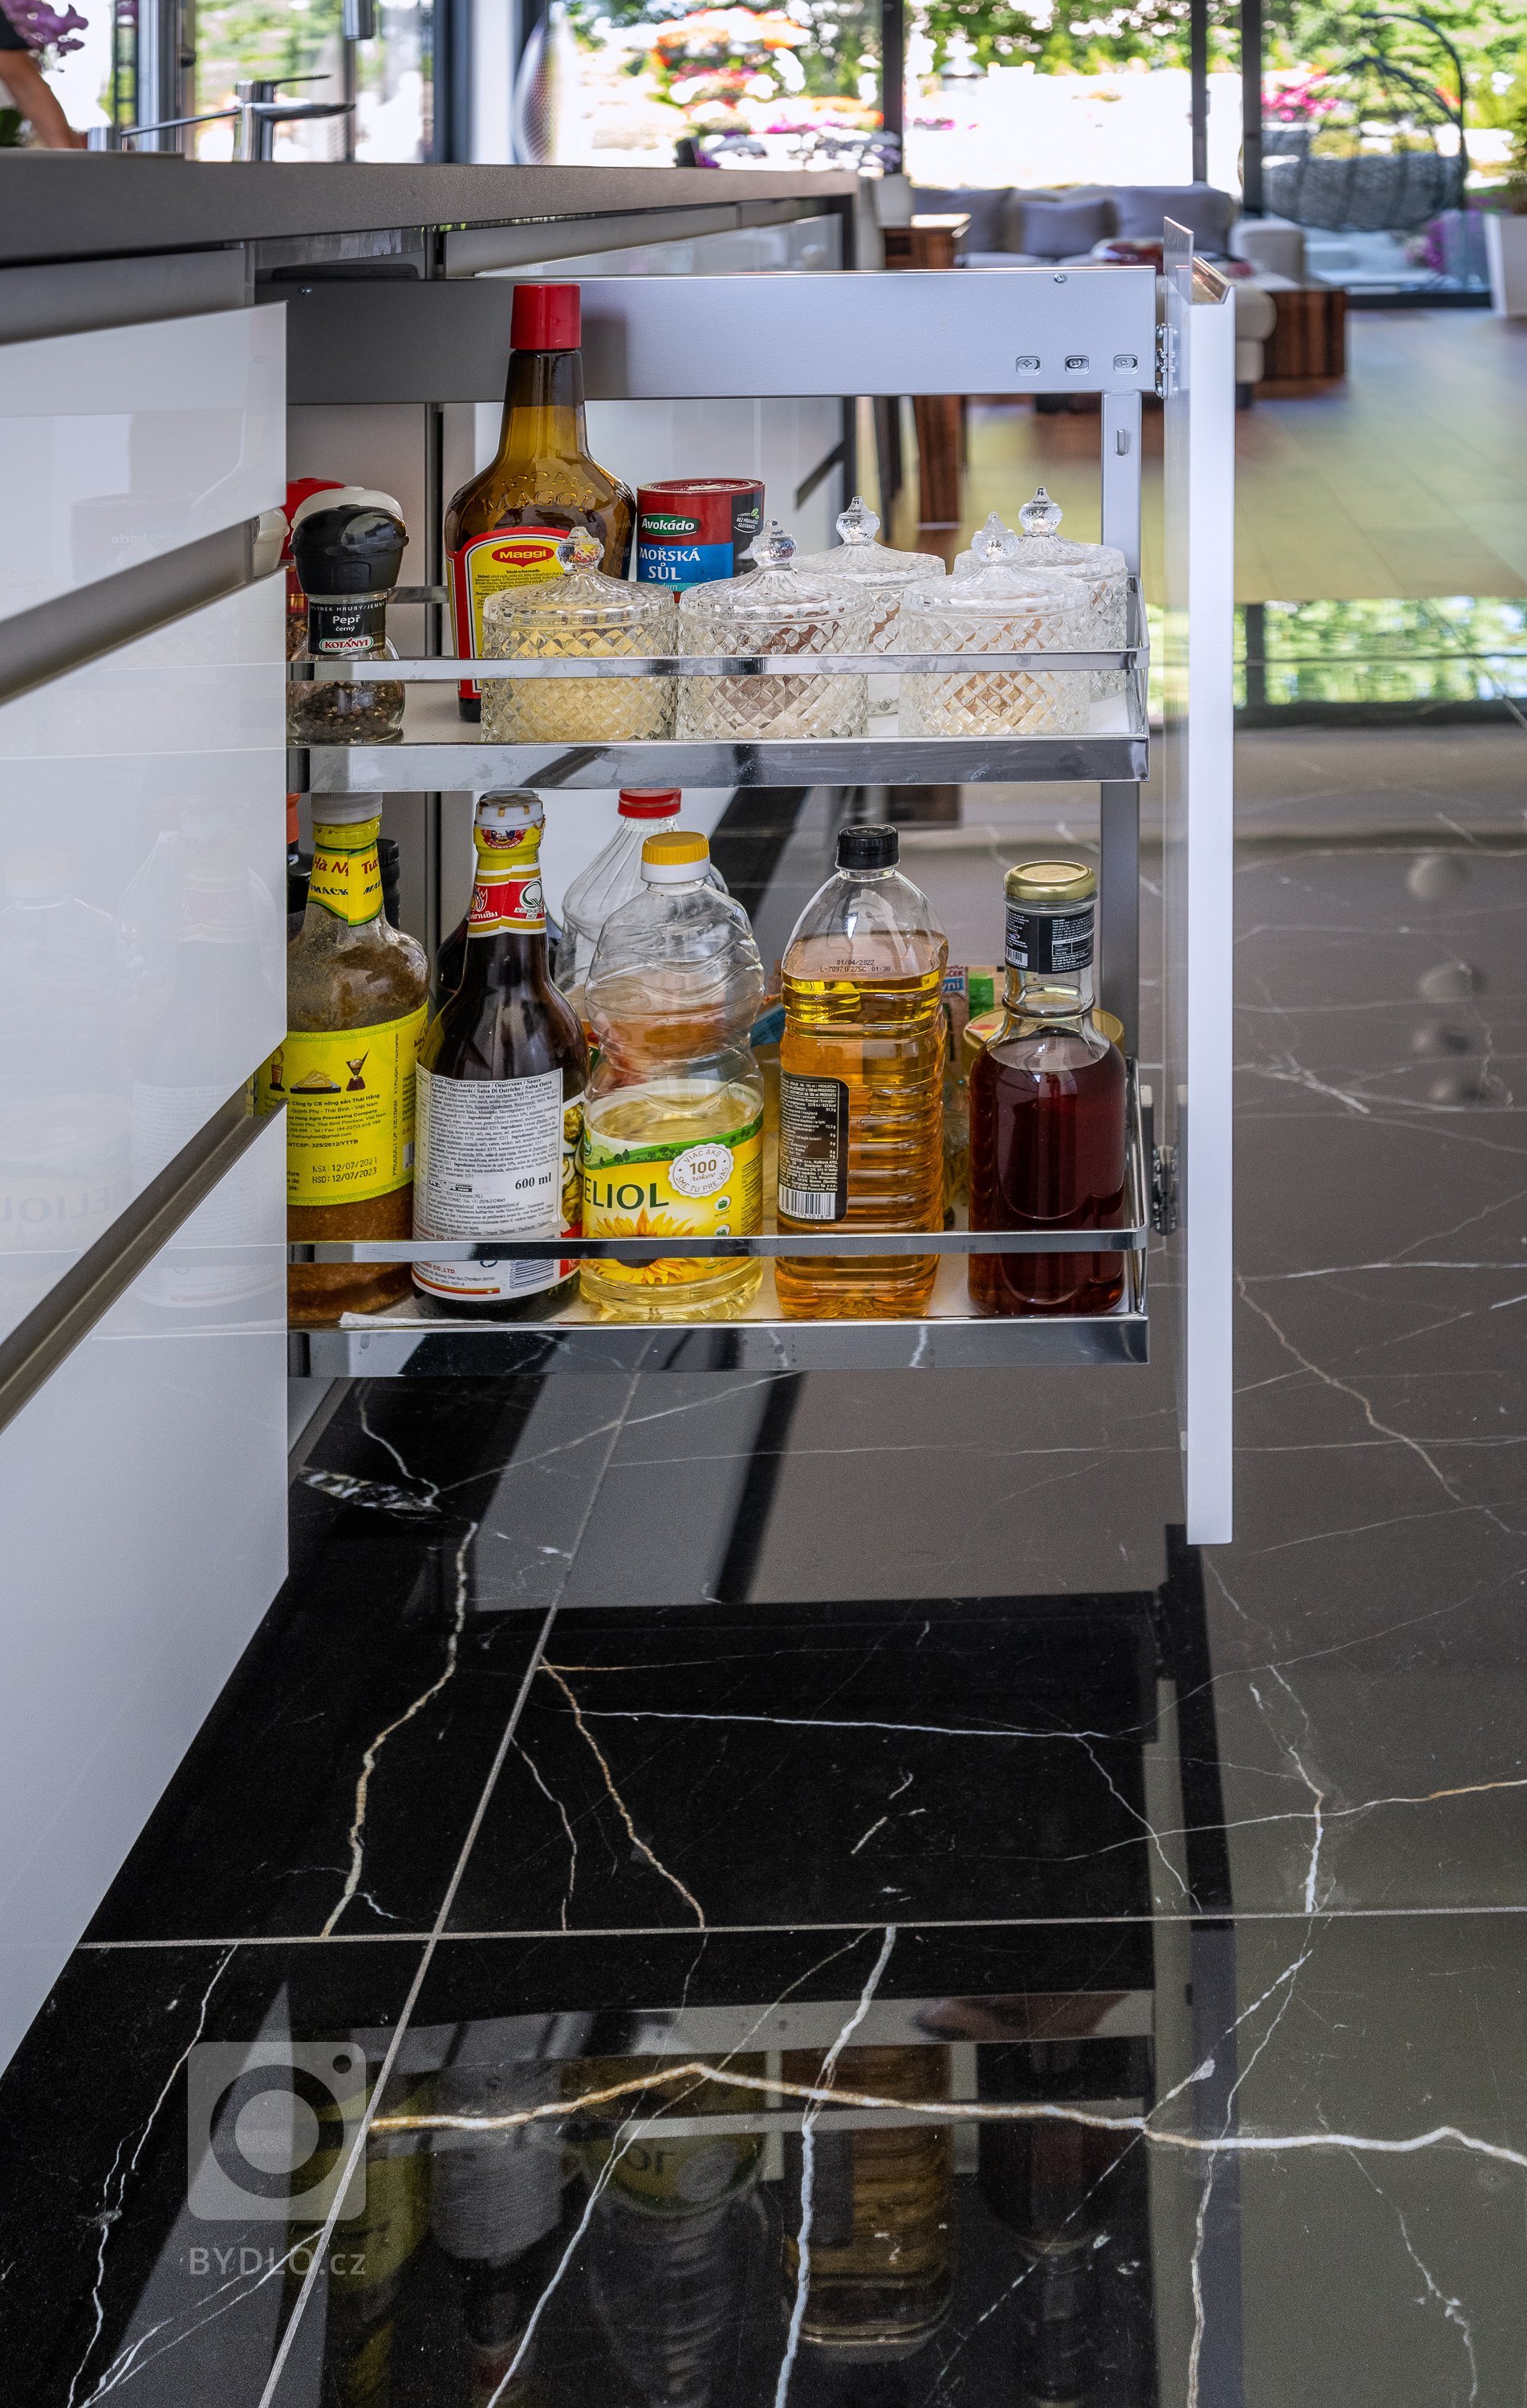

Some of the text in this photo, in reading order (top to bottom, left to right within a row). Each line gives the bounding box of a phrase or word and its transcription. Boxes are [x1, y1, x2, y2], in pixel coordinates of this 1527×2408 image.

[642, 518, 695, 531] Avokádo
[500, 549, 546, 559] Maggi
[639, 547, 701, 562] MOŘSKÁ
[648, 563, 682, 580] SŮL
[333, 614, 361, 624] Pepř
[324, 637, 369, 649] KOTÁNYI
[313, 856, 328, 872] Hà
[366, 1100, 380, 1108] Nam
[323, 1113, 353, 1121] Processing
[353, 1108, 379, 1117] Company
[684, 1145, 721, 1163] VIAC AKO
[689, 1159, 717, 1175] 100
[515, 1172, 552, 1190] 600 ml
[676, 1166, 729, 1193] SME TU PRE VÁS
[691, 1171, 717, 1182] rokov
[584, 1176, 669, 1210] ELIOL
